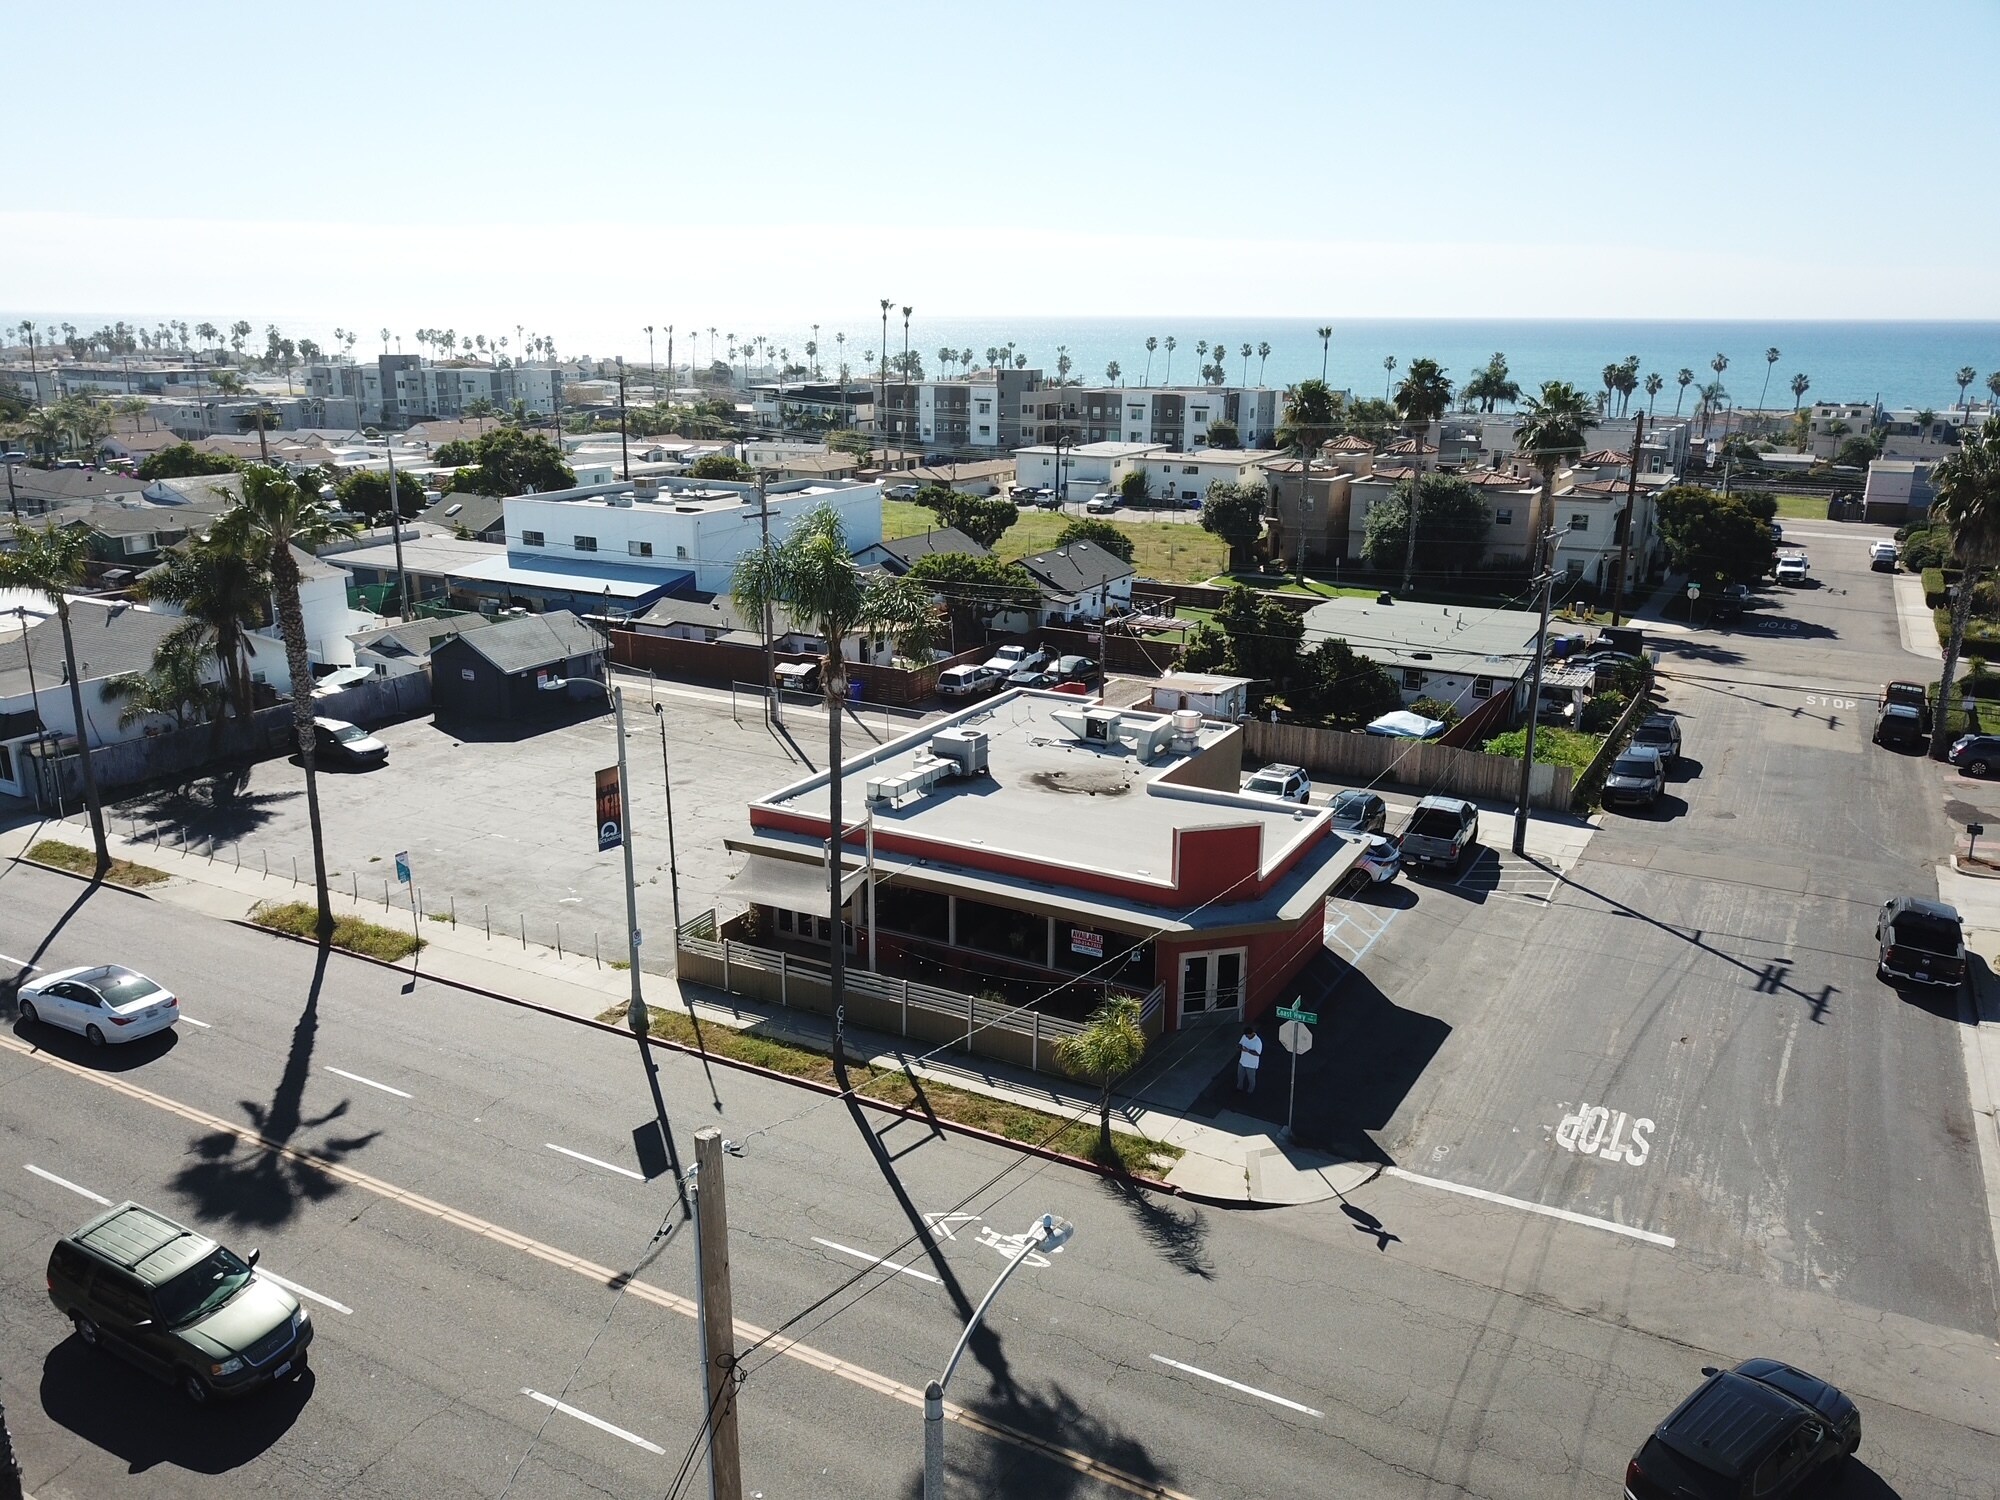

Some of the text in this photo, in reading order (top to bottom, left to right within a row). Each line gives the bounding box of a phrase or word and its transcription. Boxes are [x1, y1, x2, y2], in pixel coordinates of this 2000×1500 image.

[1758, 621, 1799, 630] STOP
[1806, 695, 1856, 710] STOP
[1073, 930, 1103, 943] AVAILABLE
[1276, 1008, 1292, 1017] Coast
[1293, 1011, 1307, 1021] Hwy
[1556, 1103, 1655, 1166] STOP
